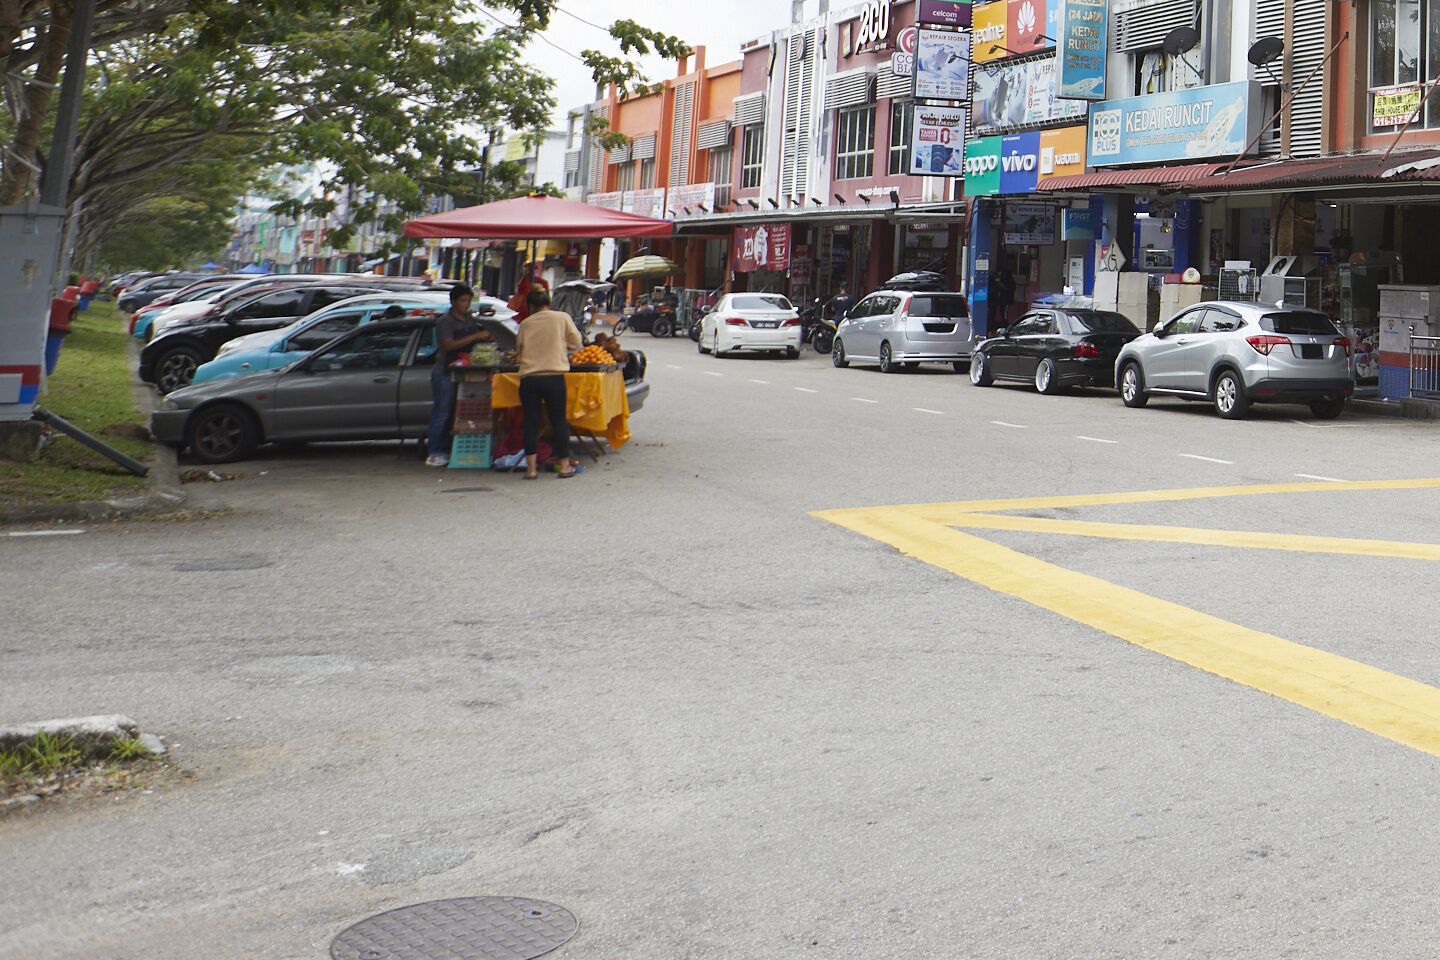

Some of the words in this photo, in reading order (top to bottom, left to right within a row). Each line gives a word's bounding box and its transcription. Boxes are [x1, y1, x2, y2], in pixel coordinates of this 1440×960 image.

[932, 8, 957, 18] celcom
[1071, 26, 1099, 38] KEDAI
[1068, 38, 1101, 52] RUNCIT
[1126, 106, 1162, 133] KEDAI
[1164, 100, 1214, 130] RUNCIT
[1096, 140, 1116, 152] PLUS
[966, 154, 998, 176] oppo
[1002, 150, 1036, 172] vivo
